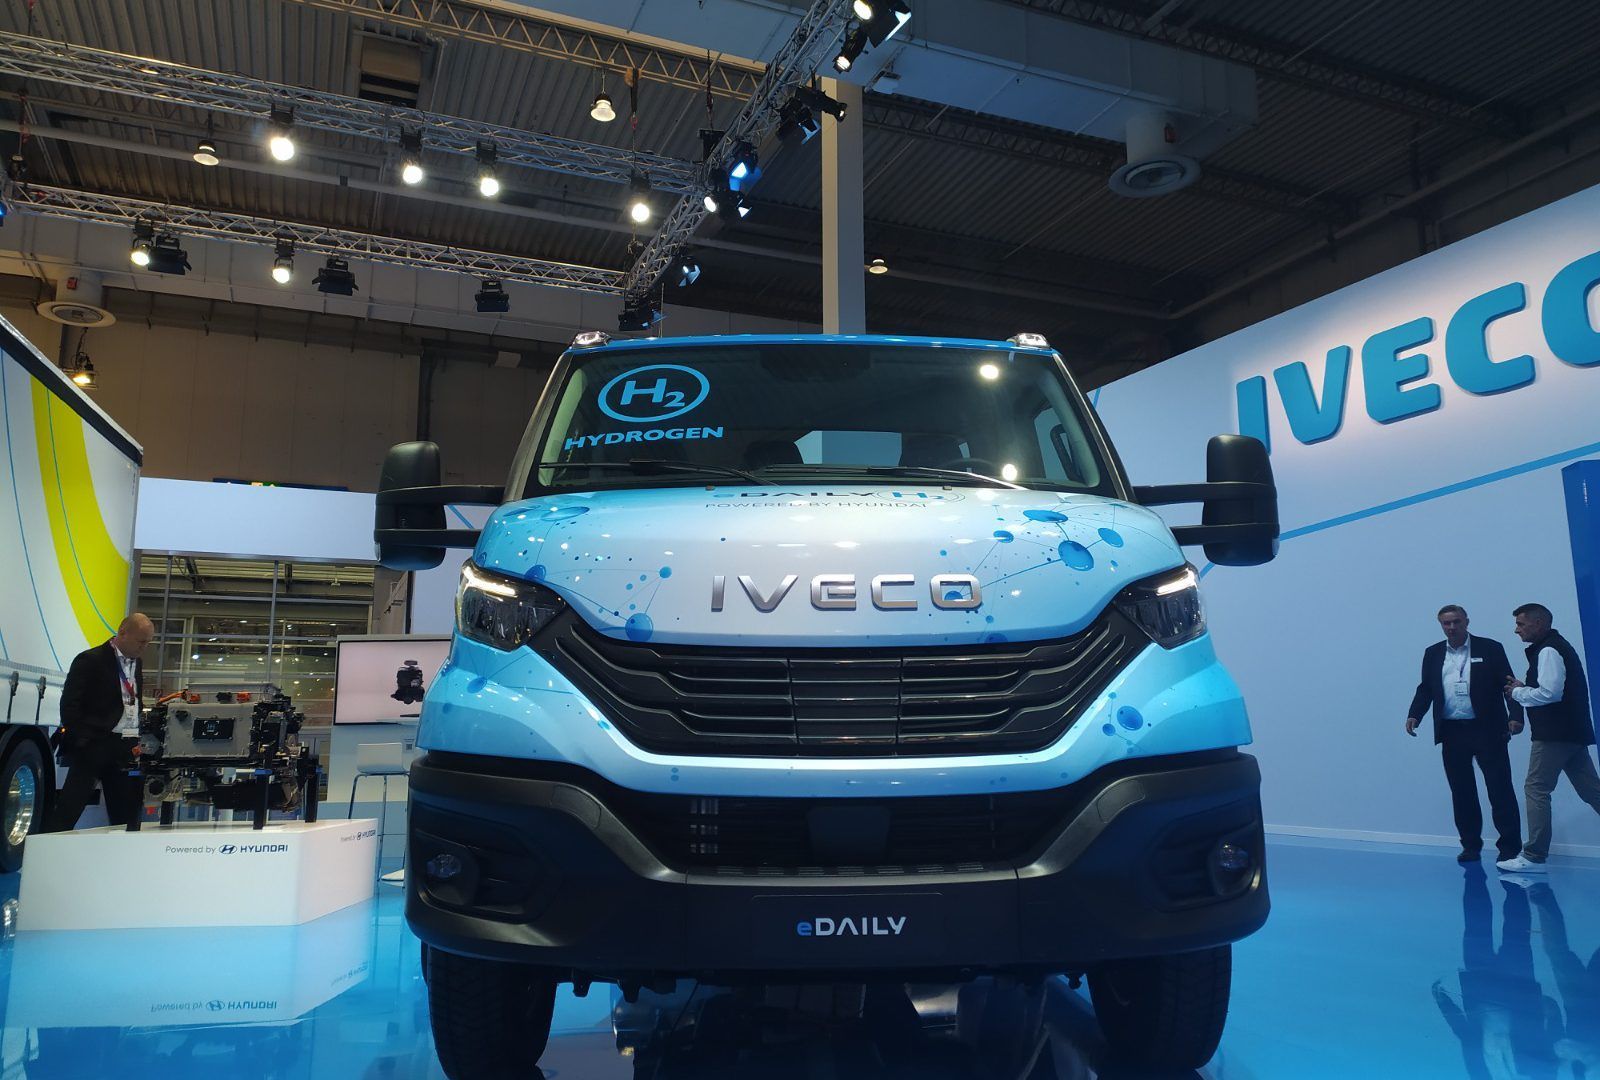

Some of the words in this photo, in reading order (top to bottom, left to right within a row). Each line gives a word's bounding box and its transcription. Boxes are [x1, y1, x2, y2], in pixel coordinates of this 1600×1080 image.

[620, 378, 686, 408] H2
[564, 426, 724, 451] HYDROGEN
[711, 573, 983, 613] IVECO
[165, 845, 203, 854] Powered
[205, 845, 216, 855] by
[240, 844, 288, 853] HYUNDAI
[797, 916, 906, 936] eDAILY
